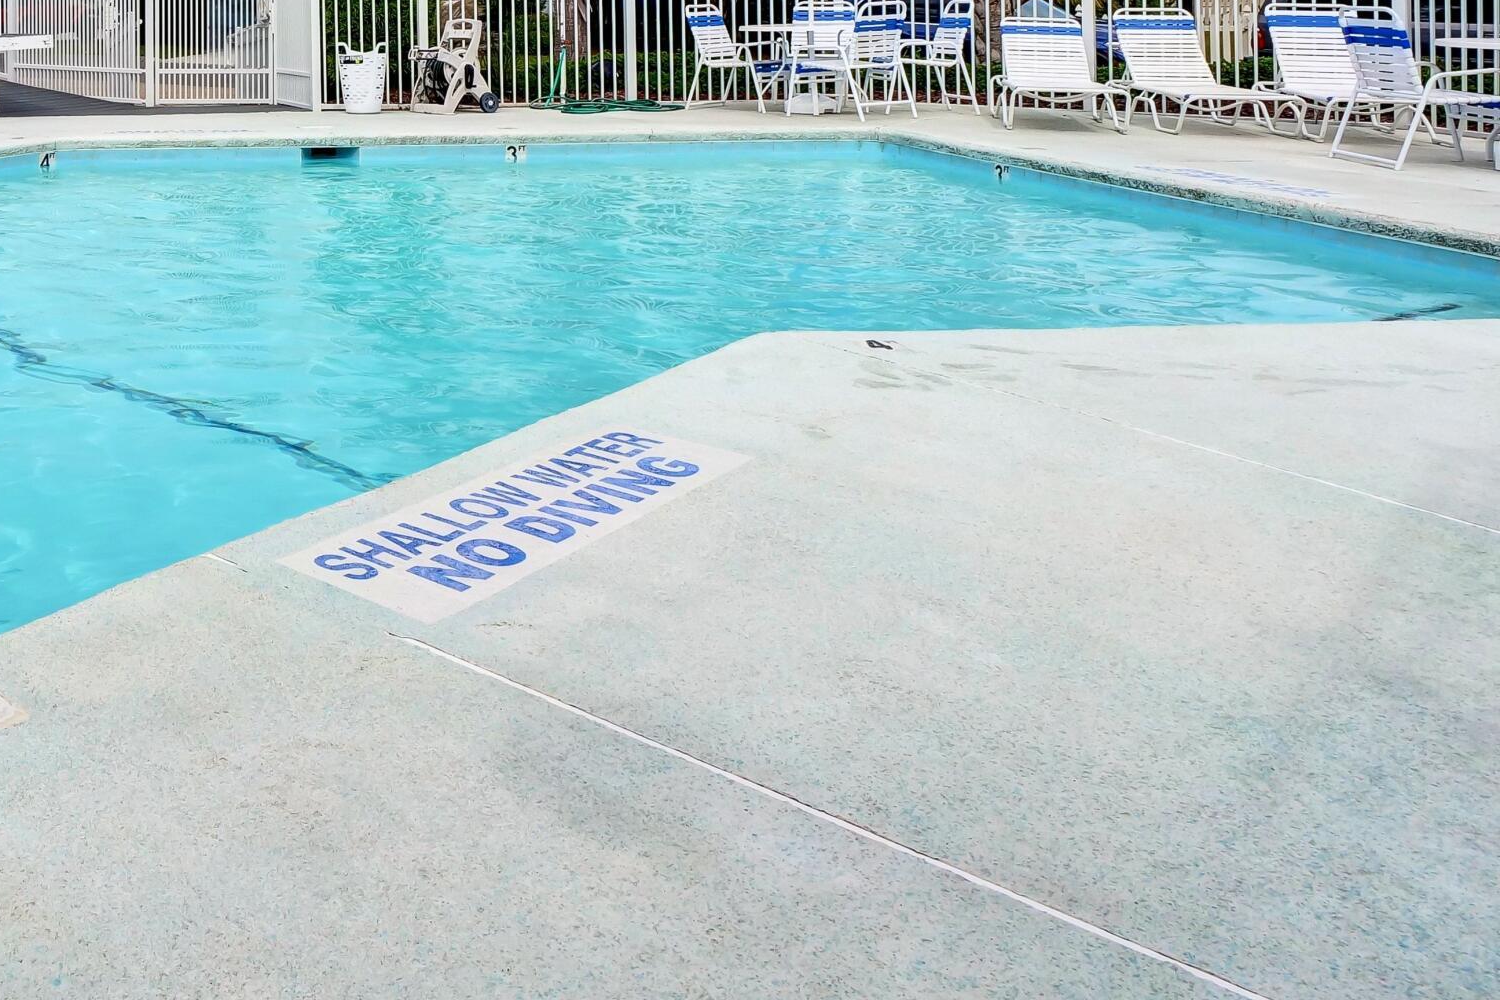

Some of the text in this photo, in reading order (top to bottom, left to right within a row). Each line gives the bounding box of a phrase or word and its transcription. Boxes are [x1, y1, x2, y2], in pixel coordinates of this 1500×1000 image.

[314, 431, 666, 580] SHALLOW WATER
[406, 456, 700, 592] NO DIVING
